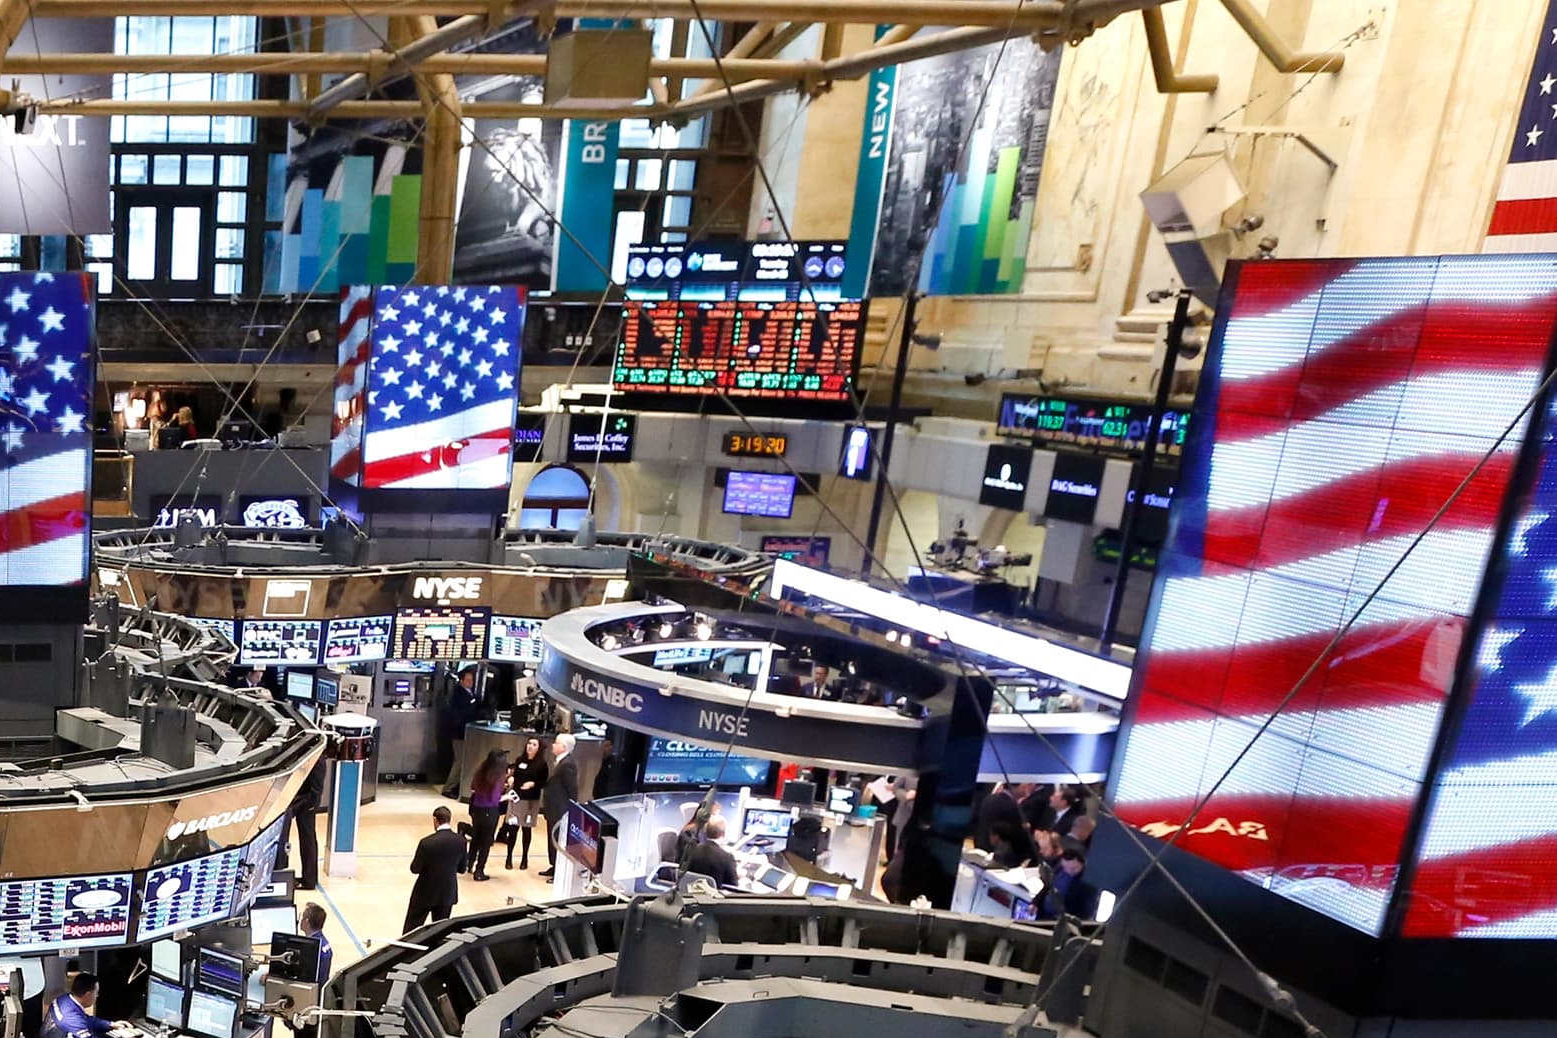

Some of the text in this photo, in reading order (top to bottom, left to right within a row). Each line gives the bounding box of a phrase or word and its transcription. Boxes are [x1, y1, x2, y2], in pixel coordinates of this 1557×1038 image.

[868, 81, 890, 159] NEW
[413, 576, 483, 599] NYSE
[583, 679, 644, 713] CNBC
[698, 708, 751, 738] NYSE
[183, 805, 259, 837] BARCLAYS
[64, 921, 126, 937] ExxonMobil
